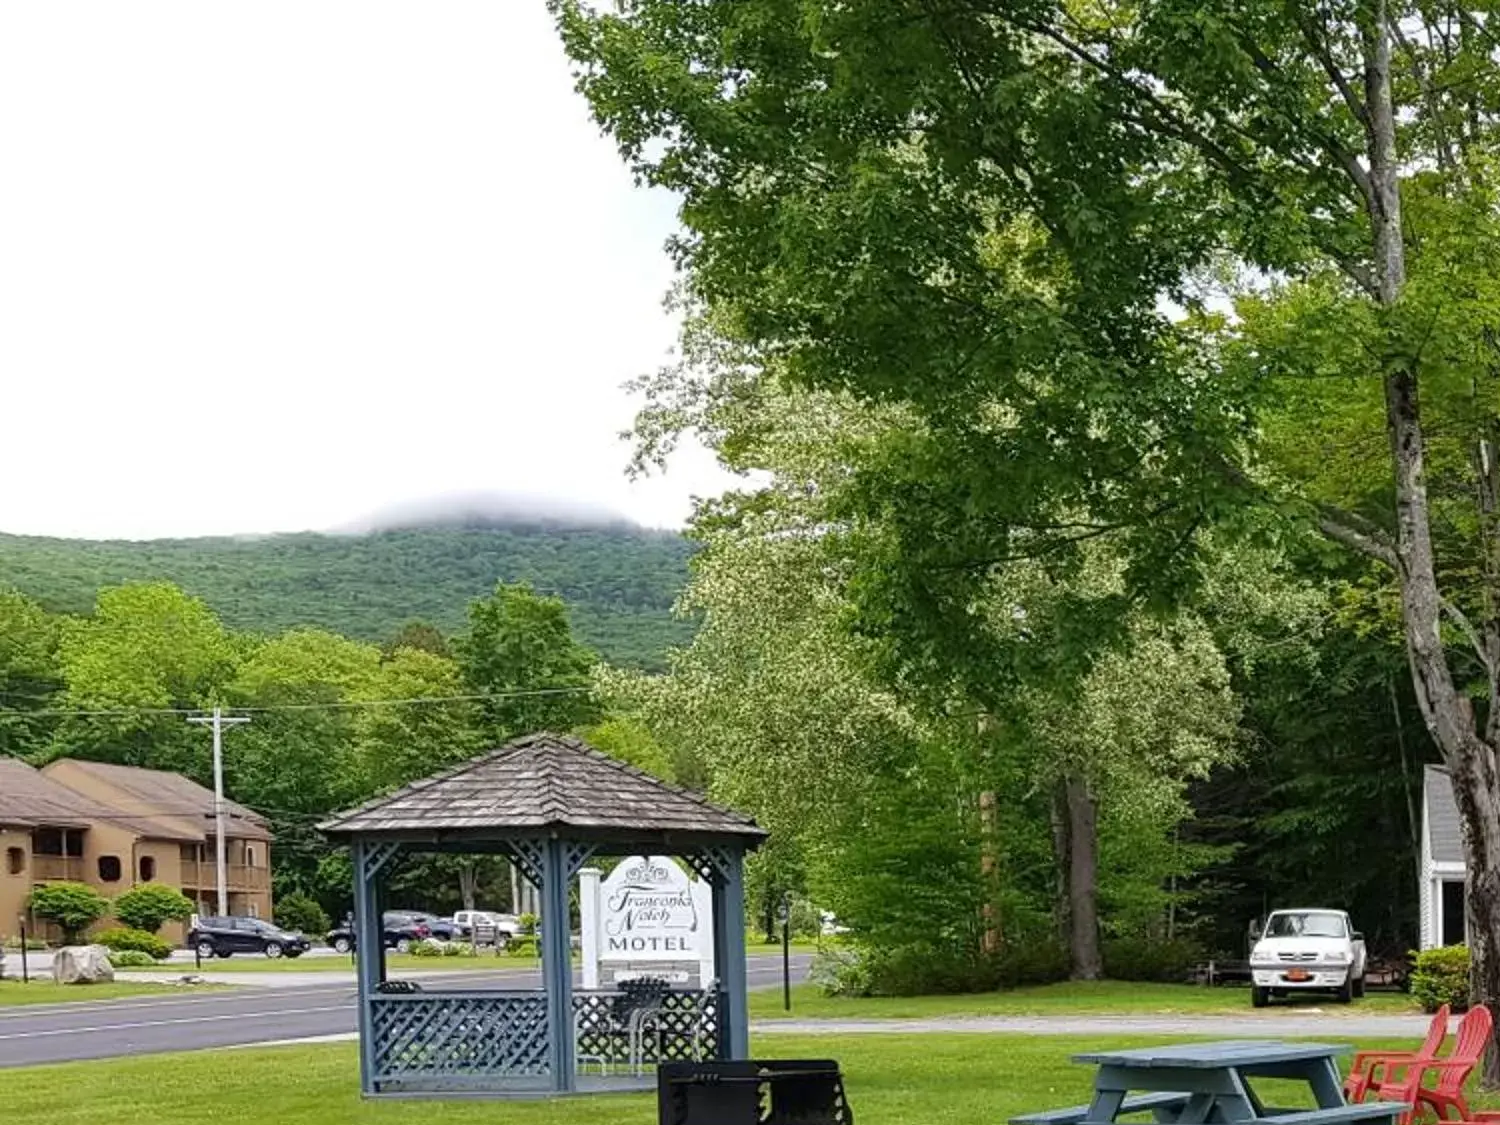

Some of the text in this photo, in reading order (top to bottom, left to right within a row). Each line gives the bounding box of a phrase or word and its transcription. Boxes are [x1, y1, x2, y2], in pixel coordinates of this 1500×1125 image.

[608, 885, 693, 912] Franconia
[606, 907, 671, 935] Notch
[608, 937, 693, 950] MOTEL
